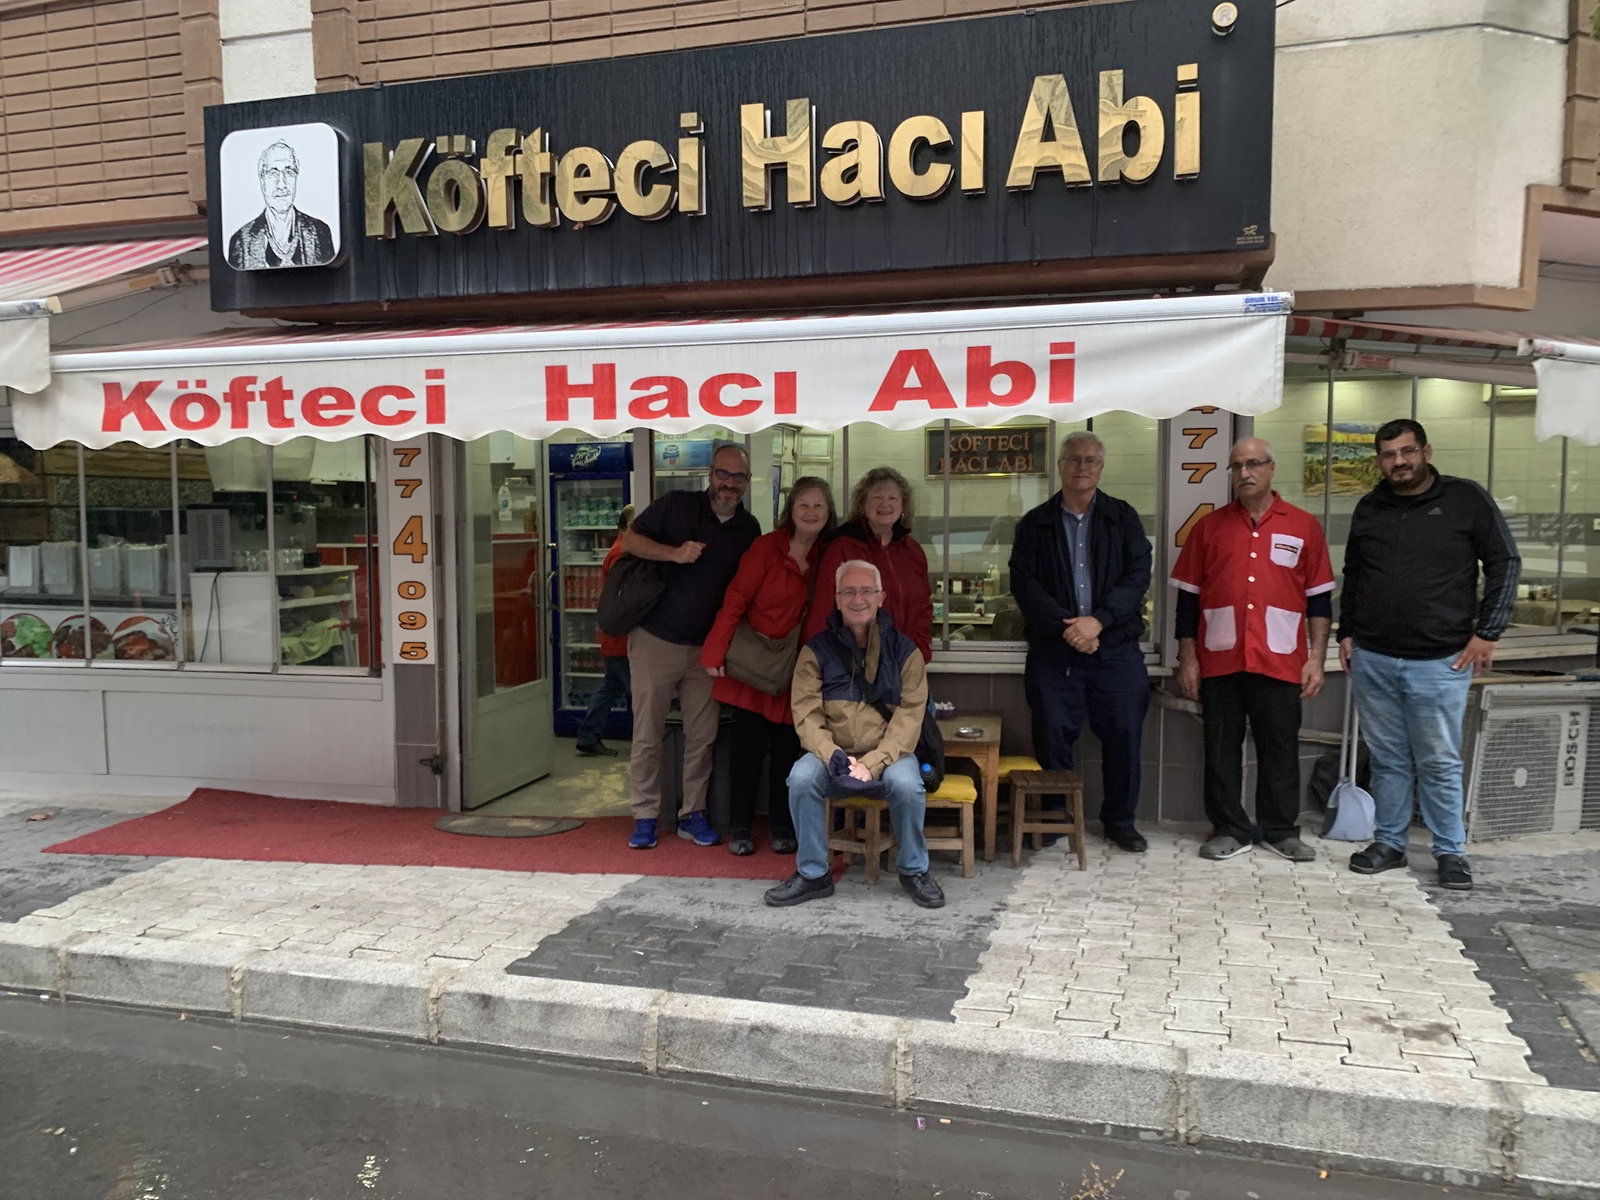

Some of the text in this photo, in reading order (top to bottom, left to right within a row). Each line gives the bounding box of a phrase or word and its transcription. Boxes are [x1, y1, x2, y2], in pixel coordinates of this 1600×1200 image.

[363, 63, 1200, 239] Köfteci Hacı Abi
[101, 341, 1076, 432] Köfteci Hacı Abi
[1175, 405, 1219, 547] 77
[1563, 711, 1580, 786] BOSCH
